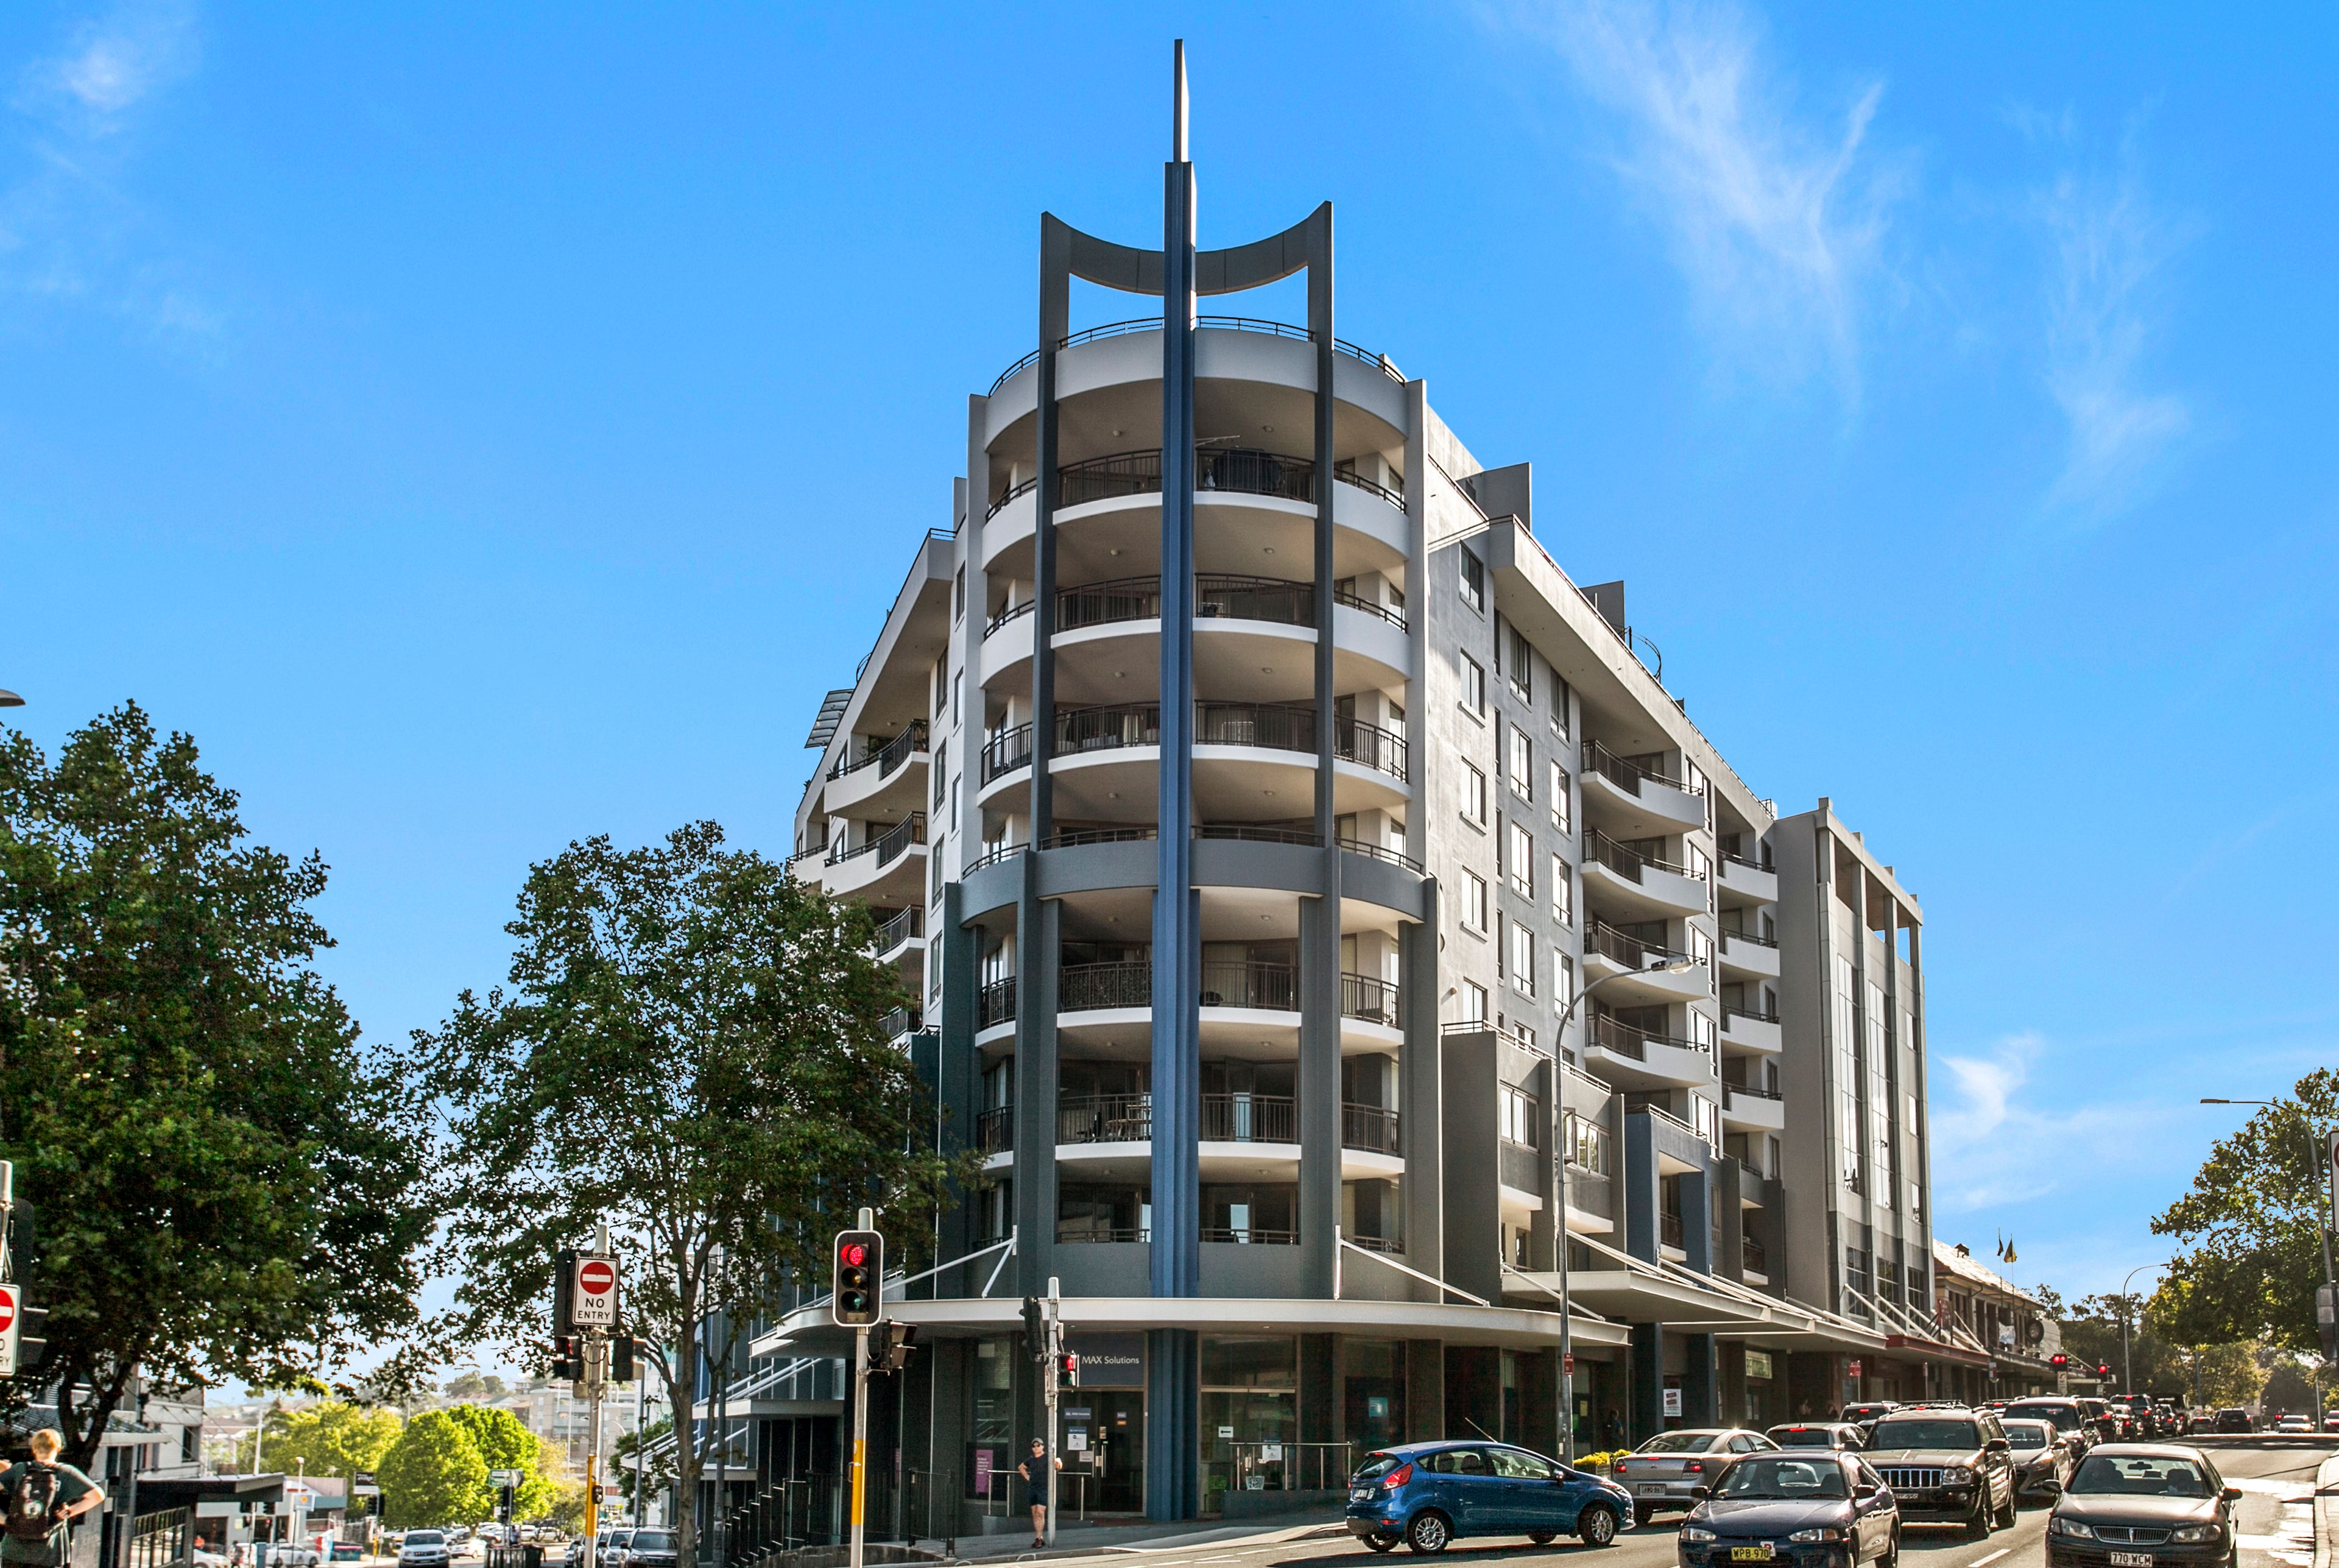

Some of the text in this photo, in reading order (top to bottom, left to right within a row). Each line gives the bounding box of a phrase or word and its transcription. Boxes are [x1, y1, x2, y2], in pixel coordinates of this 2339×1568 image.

[585, 1298, 605, 1308] NO
[577, 1310, 610, 1320] ENTRY
[1082, 1355, 1140, 1365] MAX Solutions
